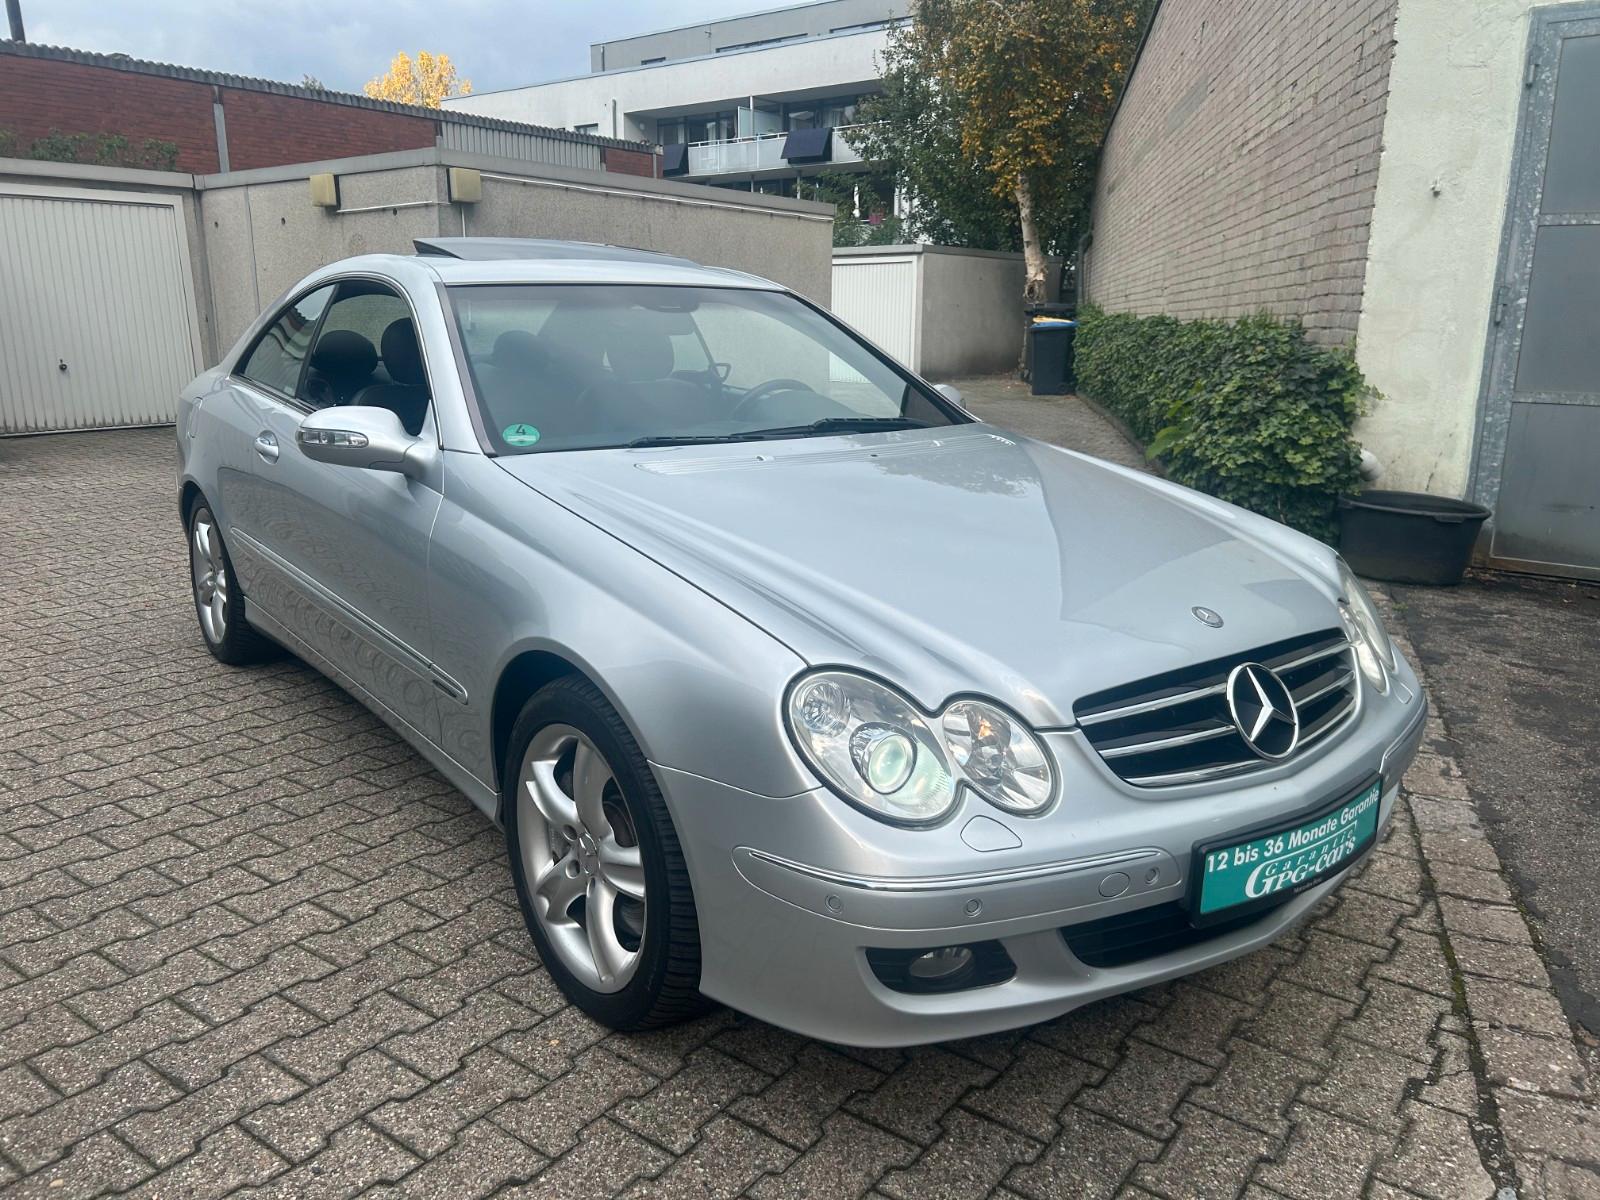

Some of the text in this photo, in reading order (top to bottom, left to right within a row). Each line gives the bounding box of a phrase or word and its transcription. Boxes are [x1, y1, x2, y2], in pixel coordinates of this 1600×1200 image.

[516, 424, 526, 436] 4
[1207, 787, 1379, 873] 12 bis 36 Monate Garantie
[1265, 829, 1353, 876] Garantie
